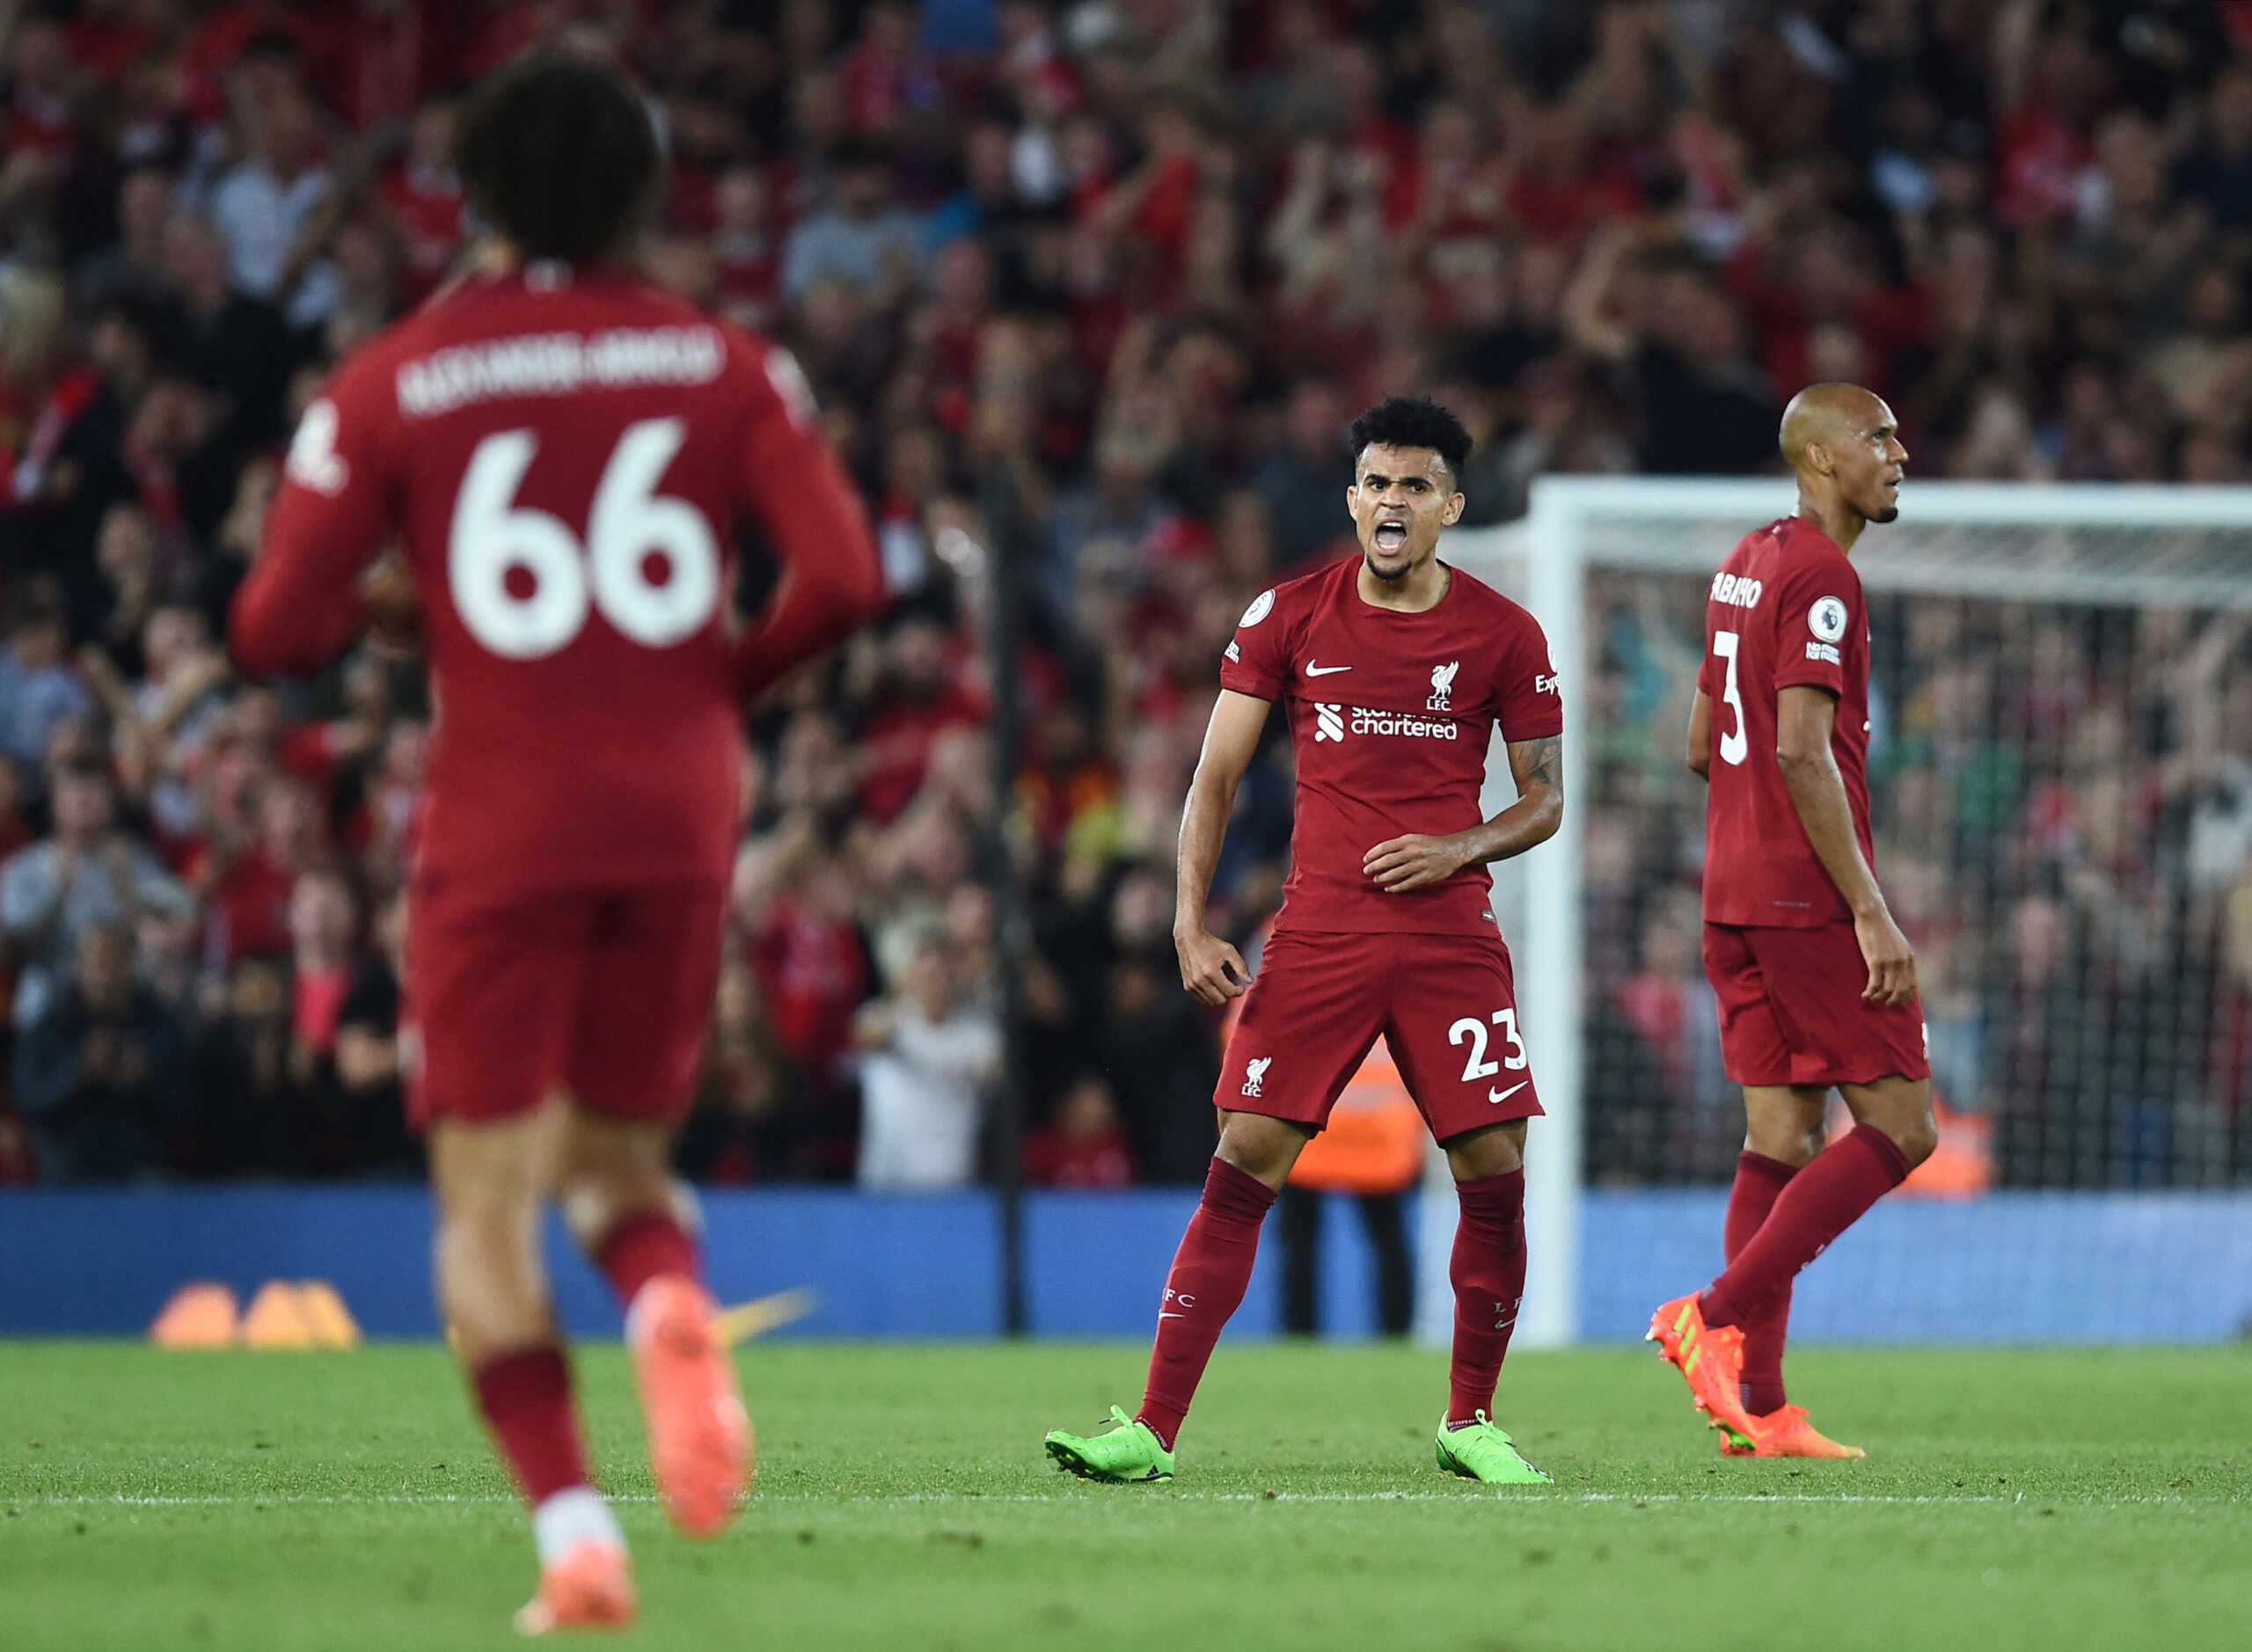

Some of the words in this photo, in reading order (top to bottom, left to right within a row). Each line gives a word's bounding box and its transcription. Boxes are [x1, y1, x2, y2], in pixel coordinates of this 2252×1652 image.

[448, 415, 720, 662] 66
[1351, 717, 1457, 740] chartered
[1713, 631, 1748, 765] 3
[1448, 1008, 1527, 1082] 23
